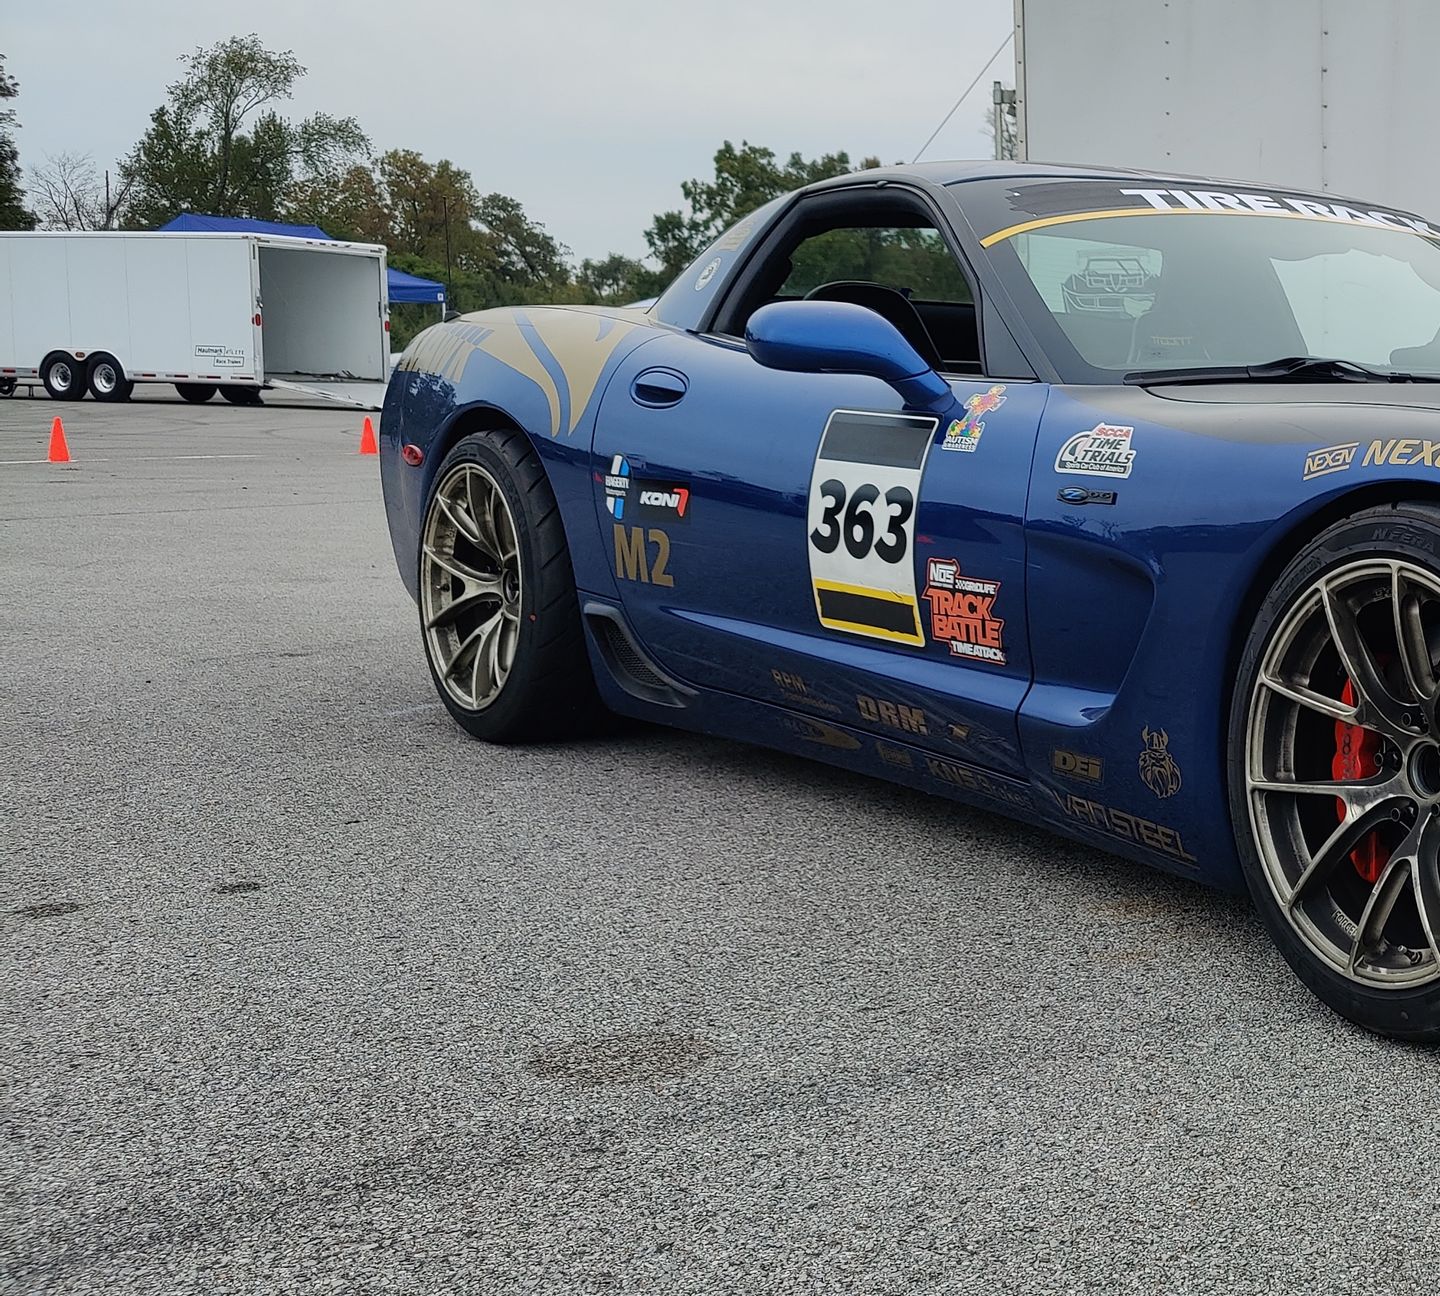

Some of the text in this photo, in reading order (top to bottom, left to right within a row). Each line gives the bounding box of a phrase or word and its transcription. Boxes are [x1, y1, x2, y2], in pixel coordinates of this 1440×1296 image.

[1119, 188, 1293, 214] TIRE
[1304, 446, 1358, 476] NEXEN
[810, 479, 914, 564] 363
[613, 523, 674, 587] M2
[926, 588, 993, 620] TRACK
[933, 614, 1001, 648] BATTLE
[951, 640, 974, 655] TIME
[1333, 910, 1358, 938] FORGE
